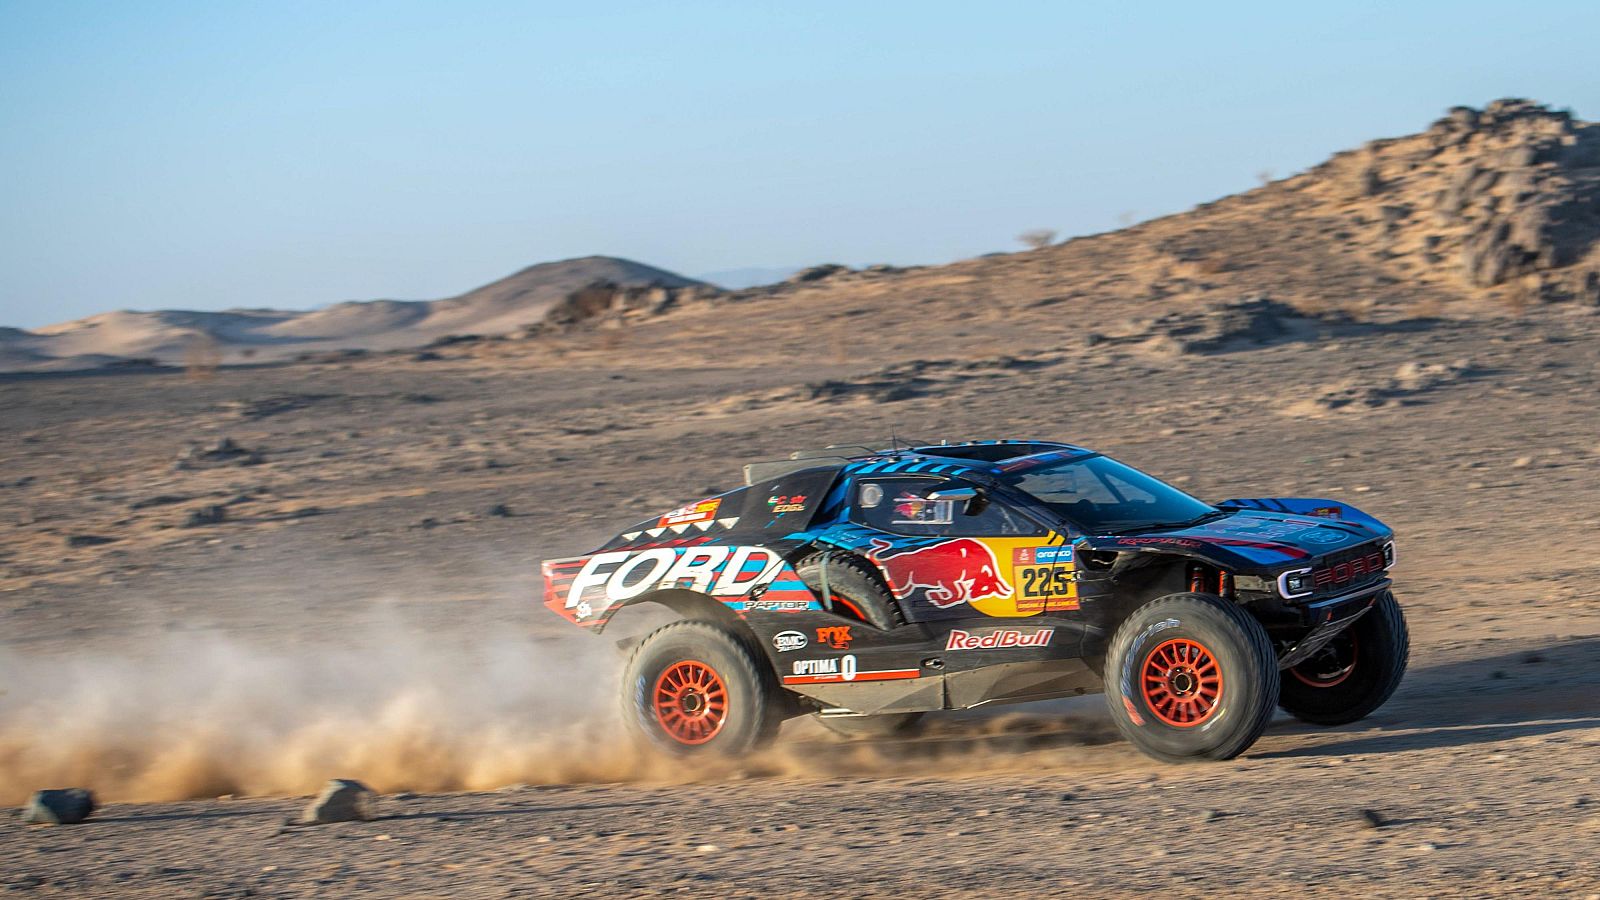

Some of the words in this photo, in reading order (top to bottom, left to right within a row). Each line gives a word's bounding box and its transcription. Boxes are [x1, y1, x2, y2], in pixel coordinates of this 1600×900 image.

[565, 545, 785, 609] FORD
[1022, 566, 1068, 597] 225
[1314, 552, 1385, 591] FORD
[743, 600, 809, 611] RAPTOR
[816, 625, 853, 650] FOX
[946, 629, 1002, 651] Red
[998, 629, 1054, 648] Bull
[792, 659, 838, 675] OPTIMA
